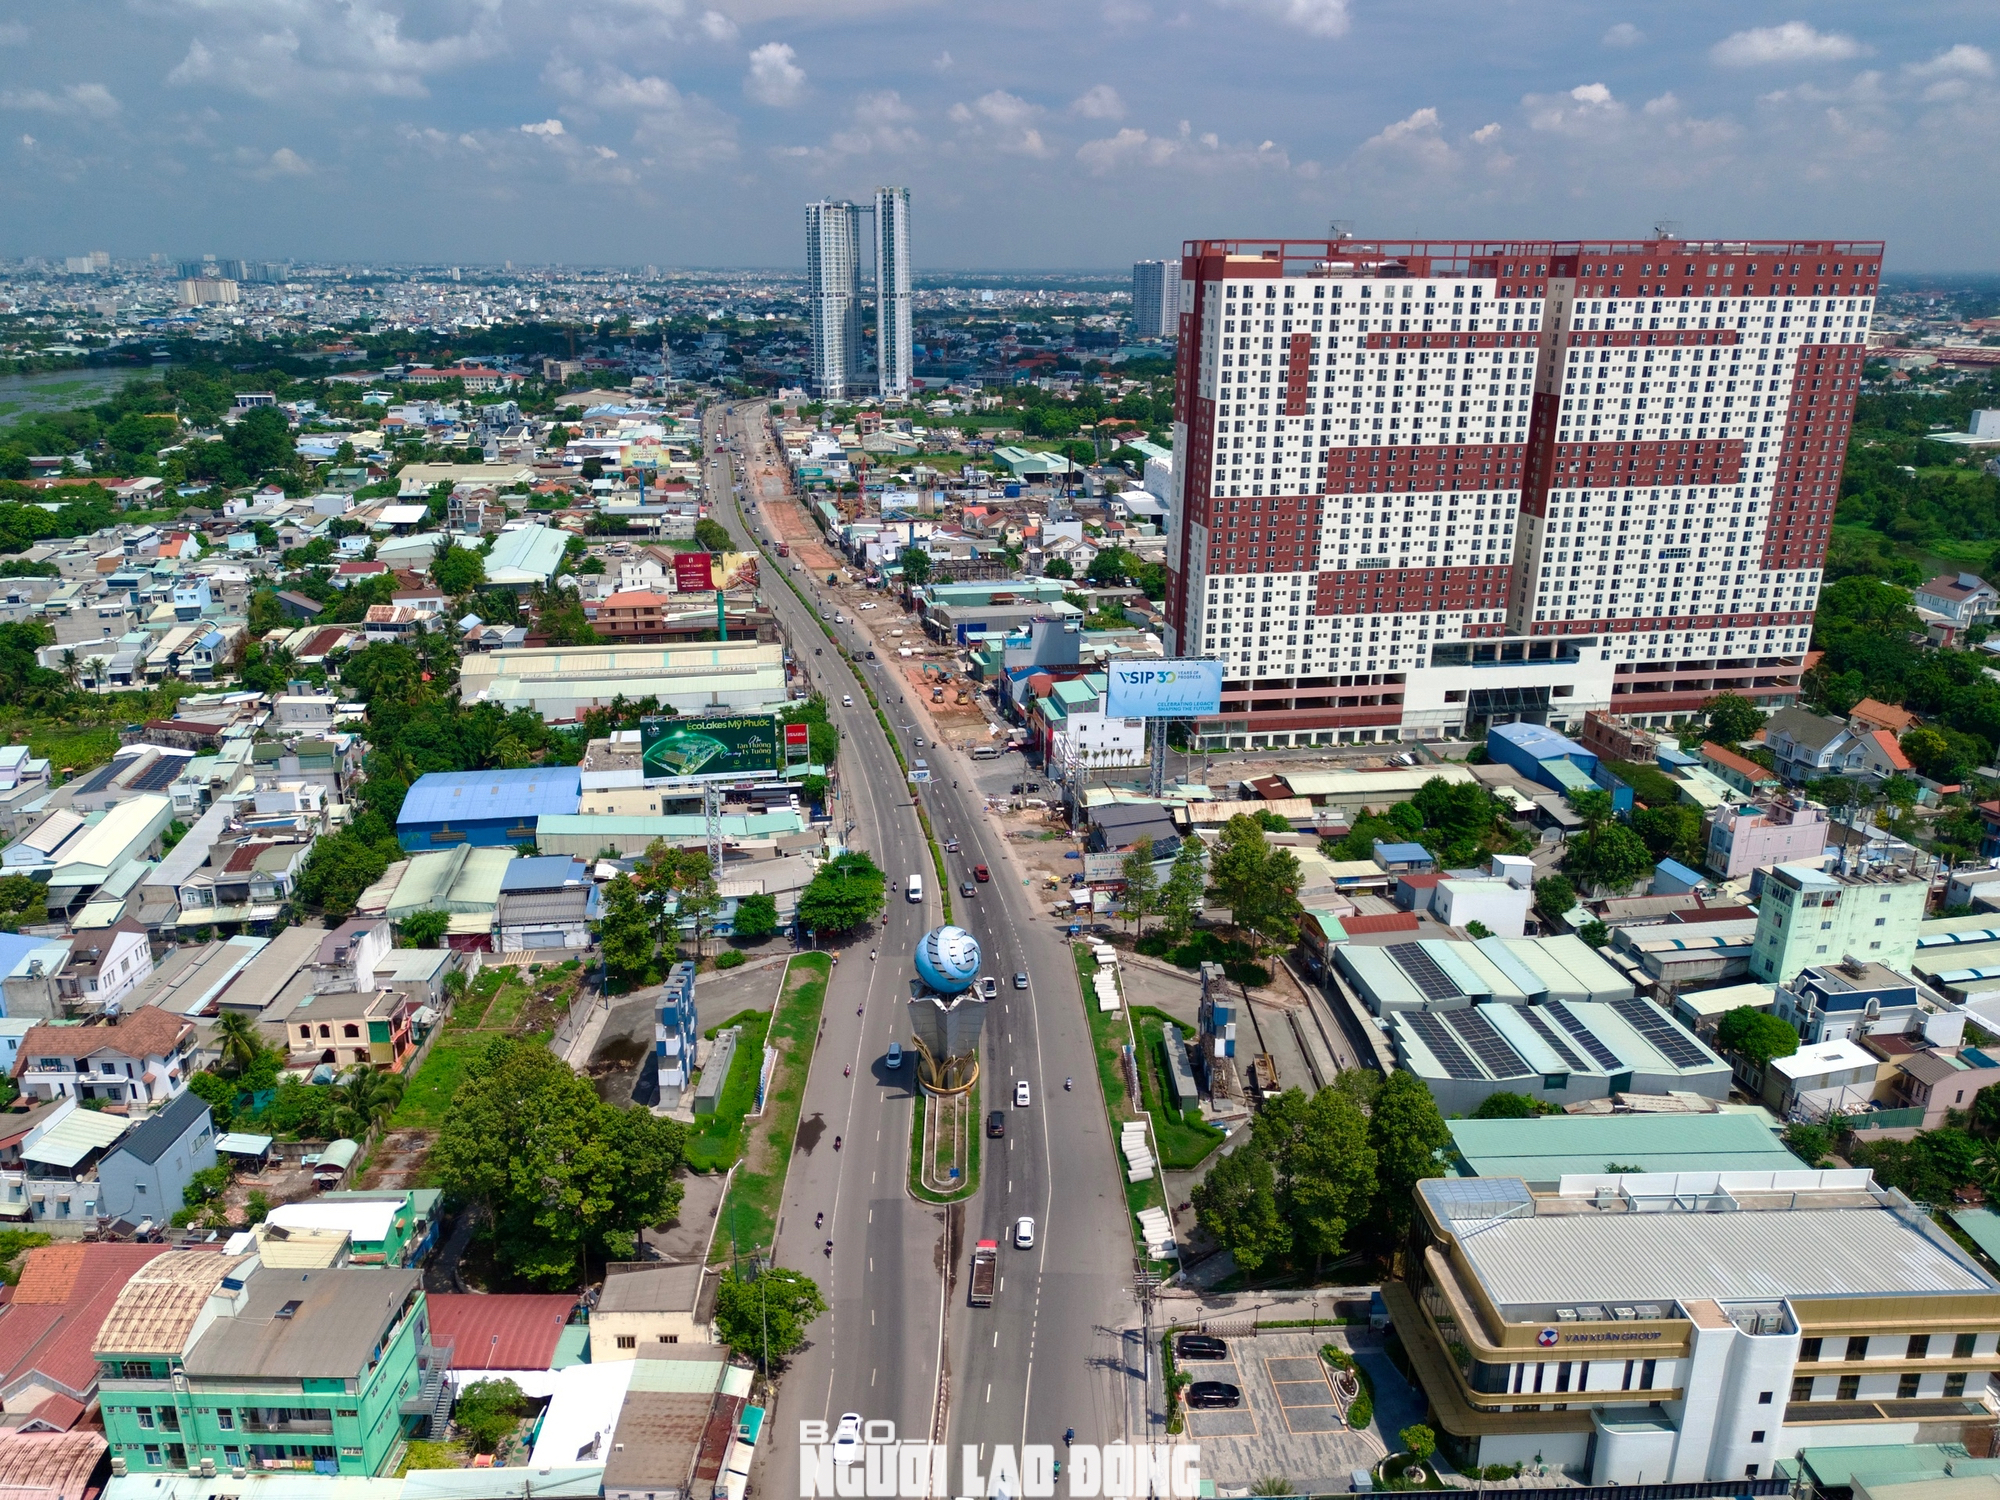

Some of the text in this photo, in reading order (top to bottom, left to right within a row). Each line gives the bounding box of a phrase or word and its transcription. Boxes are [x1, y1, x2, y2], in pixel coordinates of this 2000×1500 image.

[1116, 671, 1176, 684] VSIP 30
[686, 721, 727, 730] EcoLakes
[1621, 1331, 1662, 1340] GROUP
